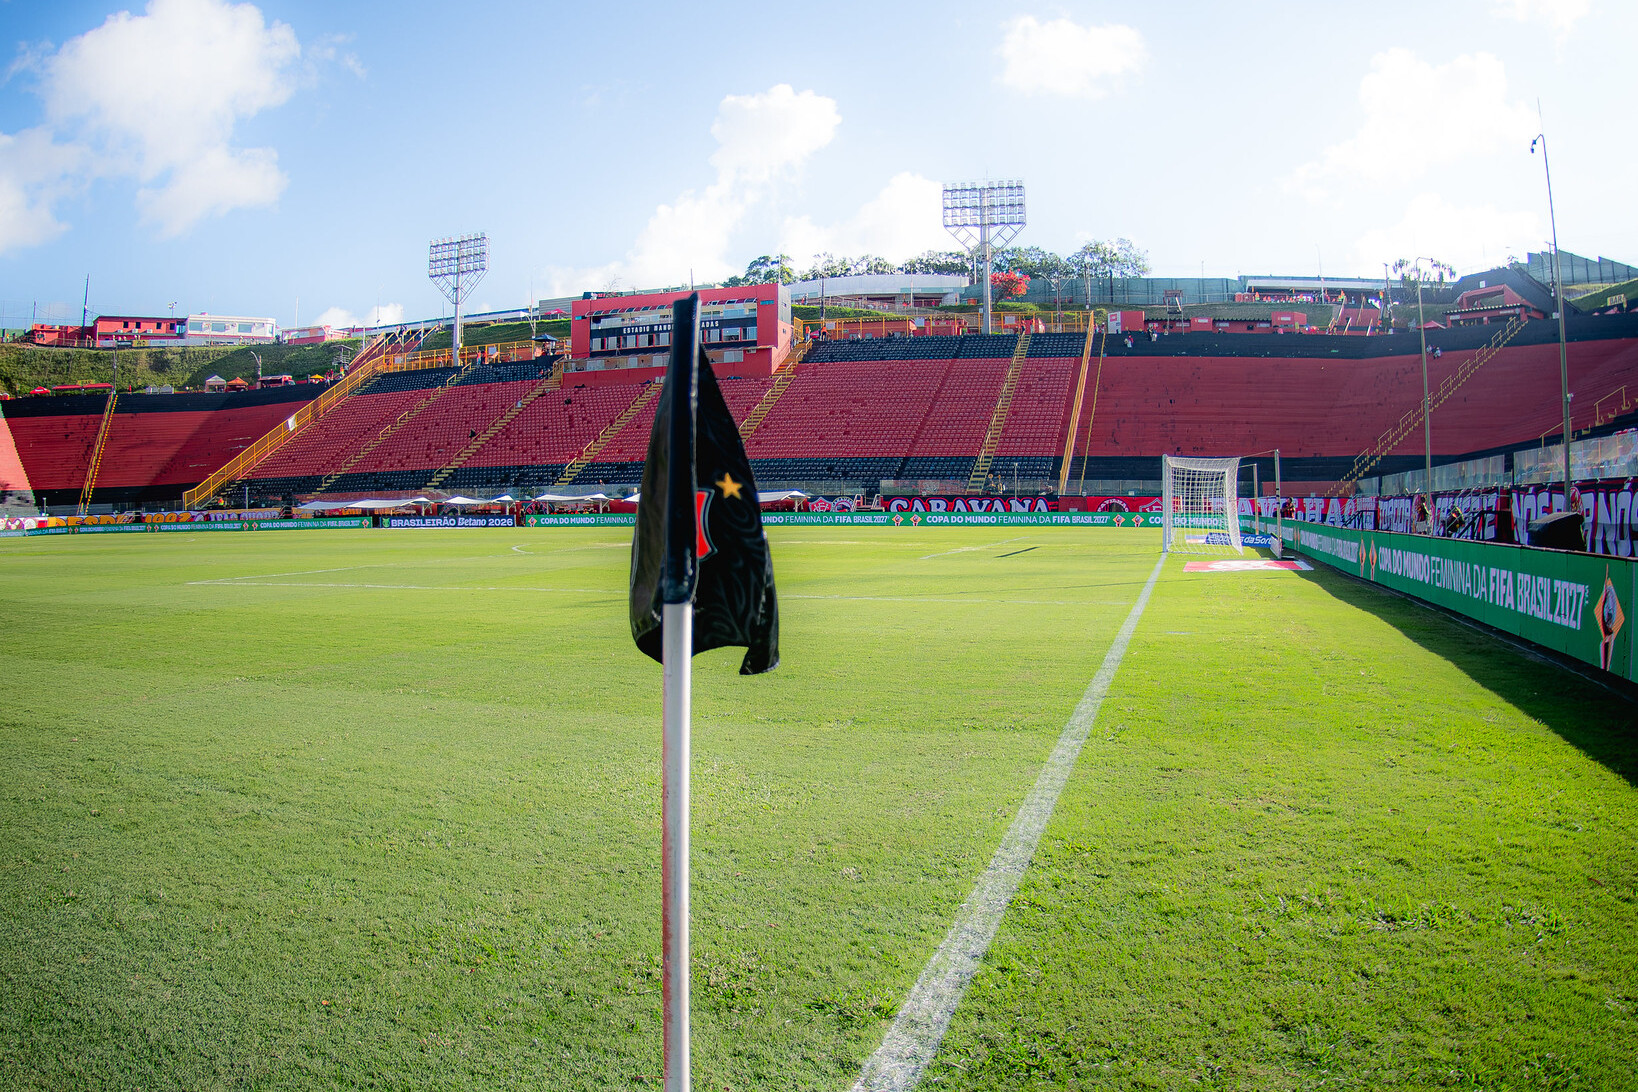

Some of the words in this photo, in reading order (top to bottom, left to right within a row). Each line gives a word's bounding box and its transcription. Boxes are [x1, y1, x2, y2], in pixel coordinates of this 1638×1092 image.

[391, 516, 456, 527] BRASILEIRÃO
[458, 518, 486, 526] Betano
[488, 518, 513, 526] 2026
[1072, 516, 1093, 524] BRASIL
[1093, 516, 1108, 524] 2027
[1149, 516, 1163, 524] CO
[1379, 546, 1392, 573] COPA
[1393, 549, 1402, 576] DO
[1403, 550, 1430, 584] MUNDO
[1431, 556, 1472, 596] FEMININA
[1474, 564, 1487, 602] DA
[1489, 568, 1514, 610] FIFA
[1517, 572, 1553, 622] BRASIL
[1553, 579, 1585, 630] 2027
